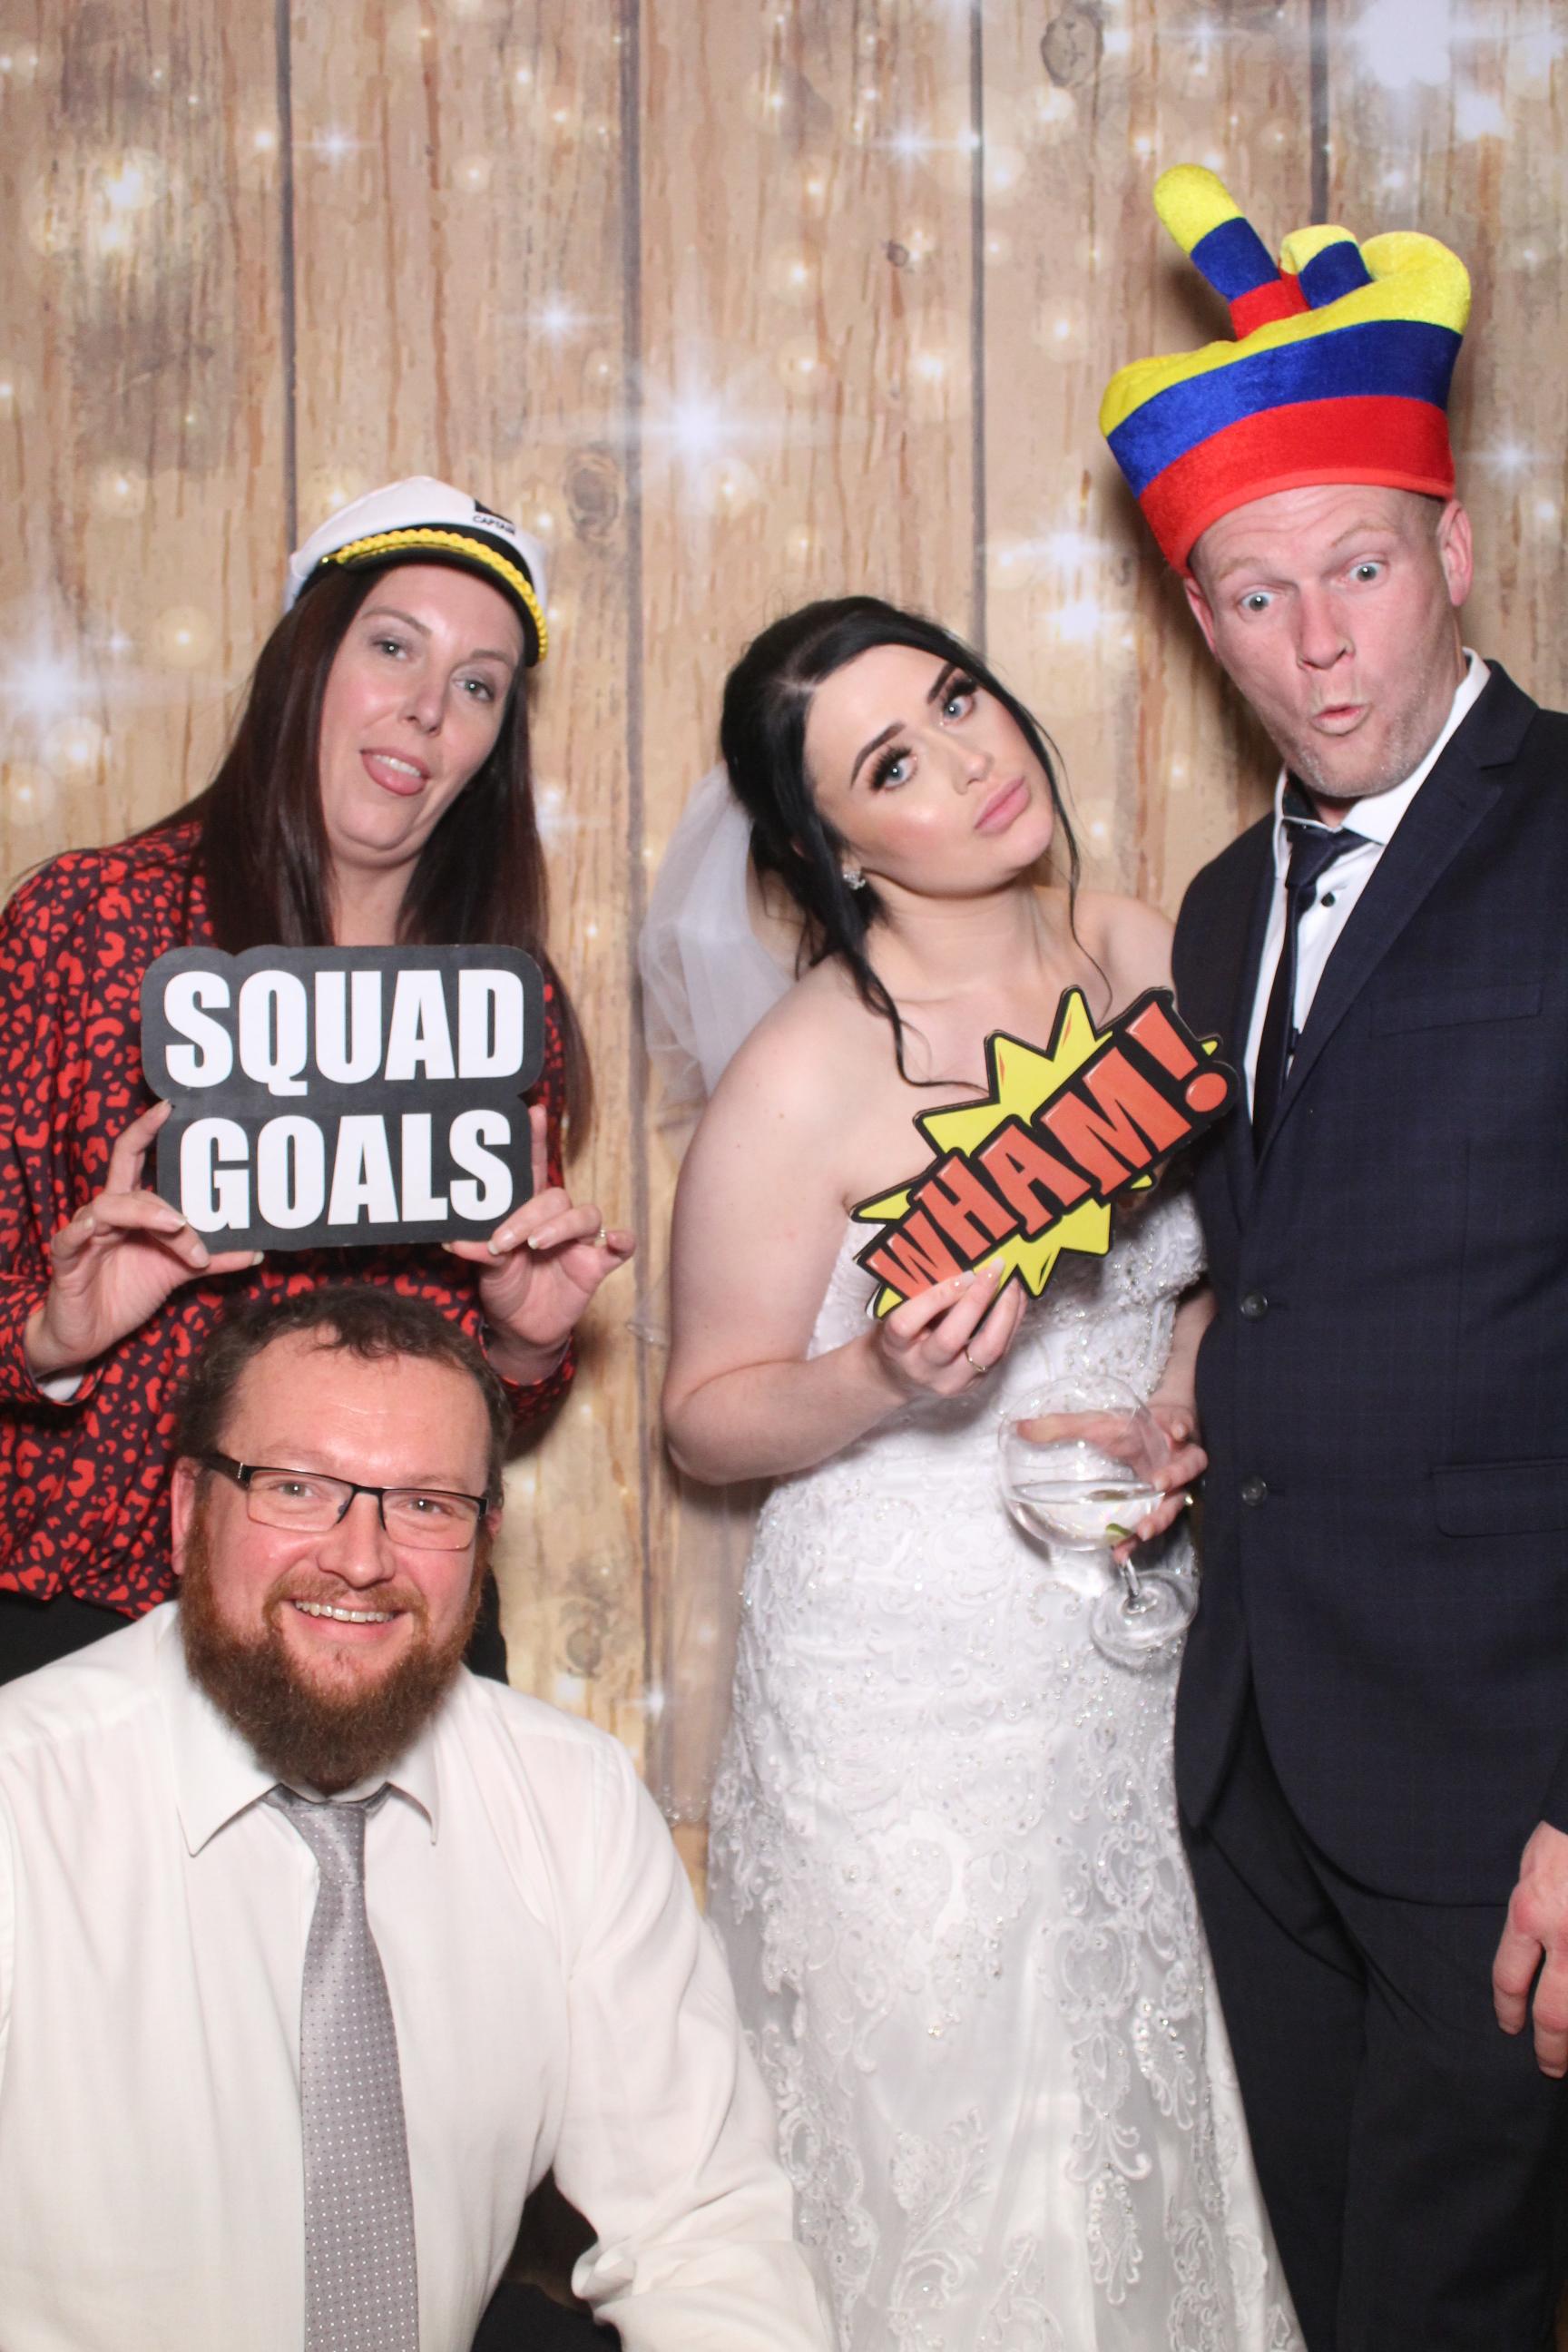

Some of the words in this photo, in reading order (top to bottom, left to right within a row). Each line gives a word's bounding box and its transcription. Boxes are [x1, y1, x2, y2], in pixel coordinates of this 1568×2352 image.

[164, 968, 524, 1097] SQUAD
[180, 1109, 514, 1233] GOALS
[865, 1000, 1228, 1299] WHAM!
